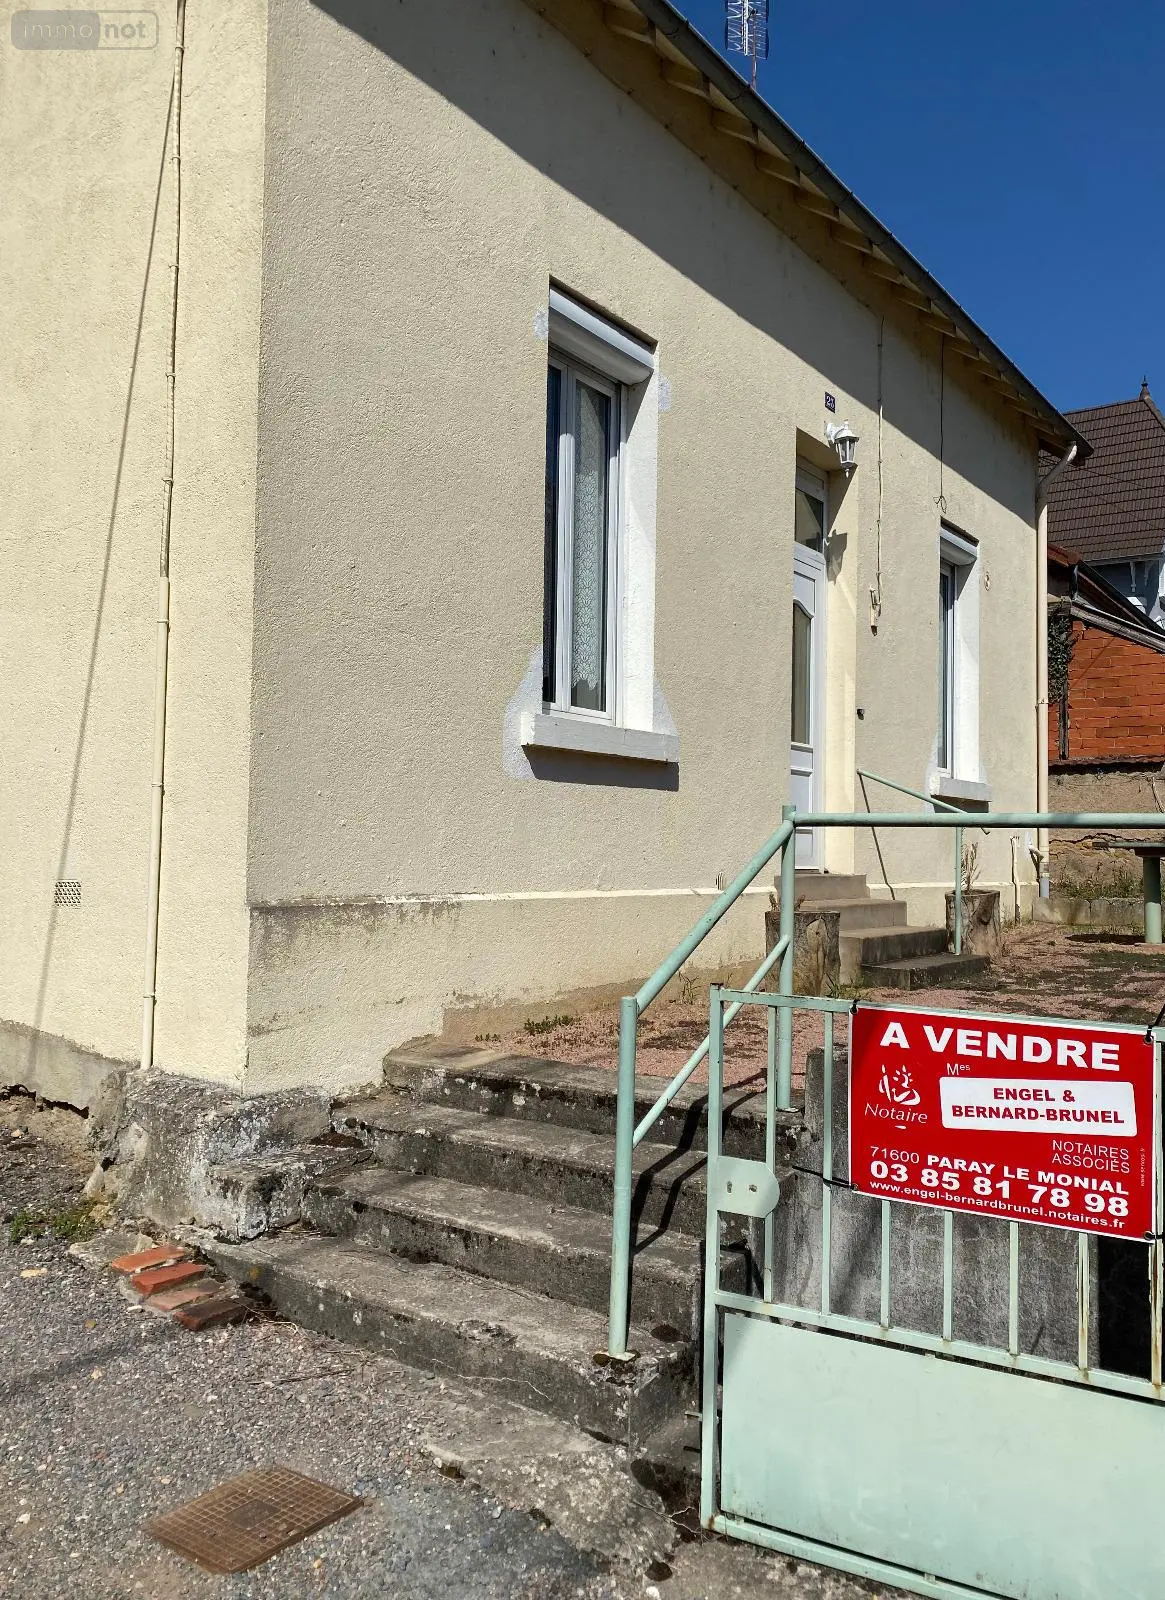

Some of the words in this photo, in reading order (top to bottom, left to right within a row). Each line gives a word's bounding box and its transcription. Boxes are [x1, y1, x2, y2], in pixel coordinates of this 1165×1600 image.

[880, 1022, 910, 1048] A
[923, 1025, 1119, 1071] VENDRE
[994, 1088, 1055, 1101] ENGEL
[1063, 1090, 1075, 1102] &
[865, 1103, 927, 1123] Notaire
[952, 1105, 1124, 1123] BERNARD-BRUNEL
[1053, 1140, 1128, 1160] NOTAIRES
[871, 1146, 919, 1163] 71600
[928, 1155, 995, 1174] PARAY
[1004, 1166, 1029, 1180] LE
[1038, 1171, 1128, 1195] MONIAL
[1052, 1153, 1129, 1173] ASSOCIÉS
[871, 1161, 908, 1182] 03
[921, 1169, 960, 1190] 85
[973, 1177, 1009, 1199] 81
[1028, 1184, 1070, 1207] 78
[1085, 1194, 1128, 1216] 98
[870, 1182, 1124, 1228] www.engel-bernardbrunel.notaires.fr
